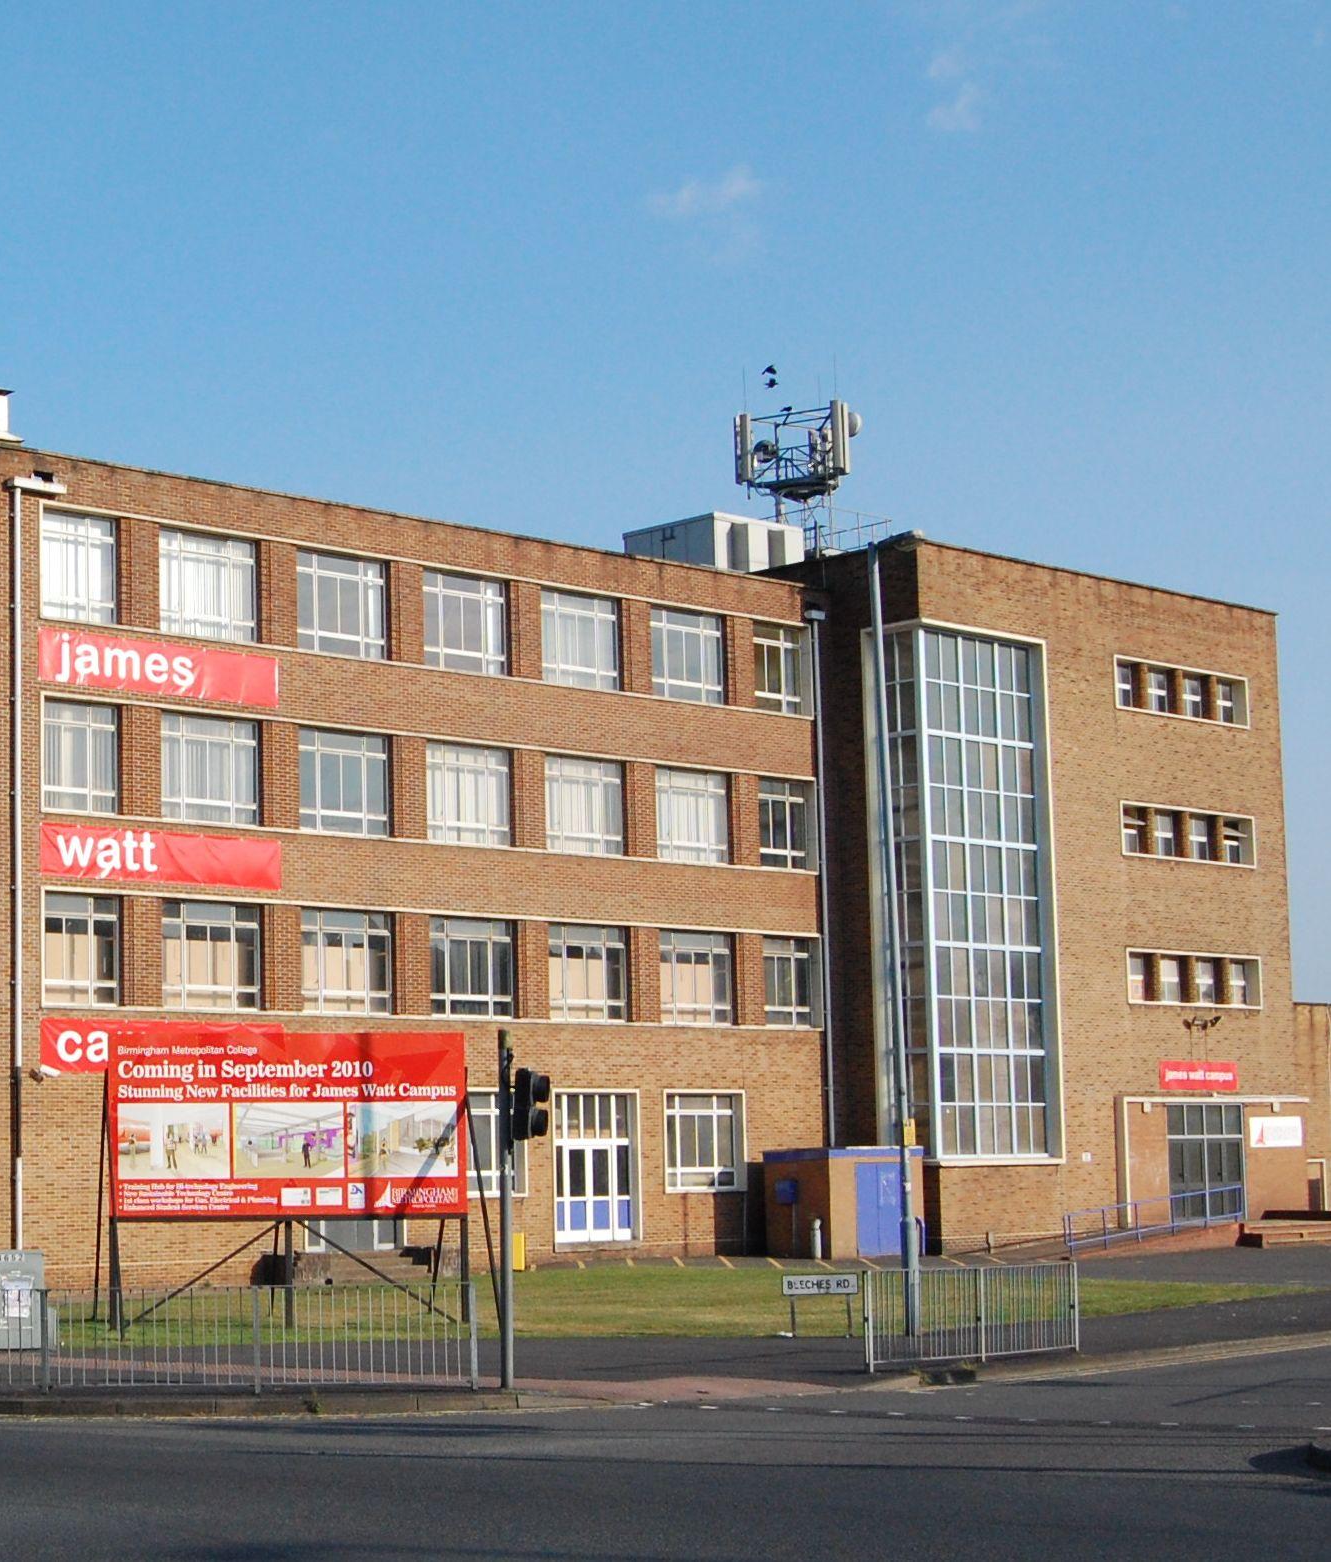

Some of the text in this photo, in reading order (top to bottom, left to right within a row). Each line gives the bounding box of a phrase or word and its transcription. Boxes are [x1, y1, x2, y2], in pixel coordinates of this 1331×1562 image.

[55, 632, 195, 687] james
[56, 830, 158, 873] watt
[117, 1046, 257, 1056] Birmingham Metropolitan College
[117, 1059, 373, 1082] Coming in September 2010
[117, 1083, 457, 1101] Stunning New Facilities for James Watt Campus
[392, 1187, 455, 1196] BIRMINGHAM
[787, 1279, 850, 1289] BEECHES RD
